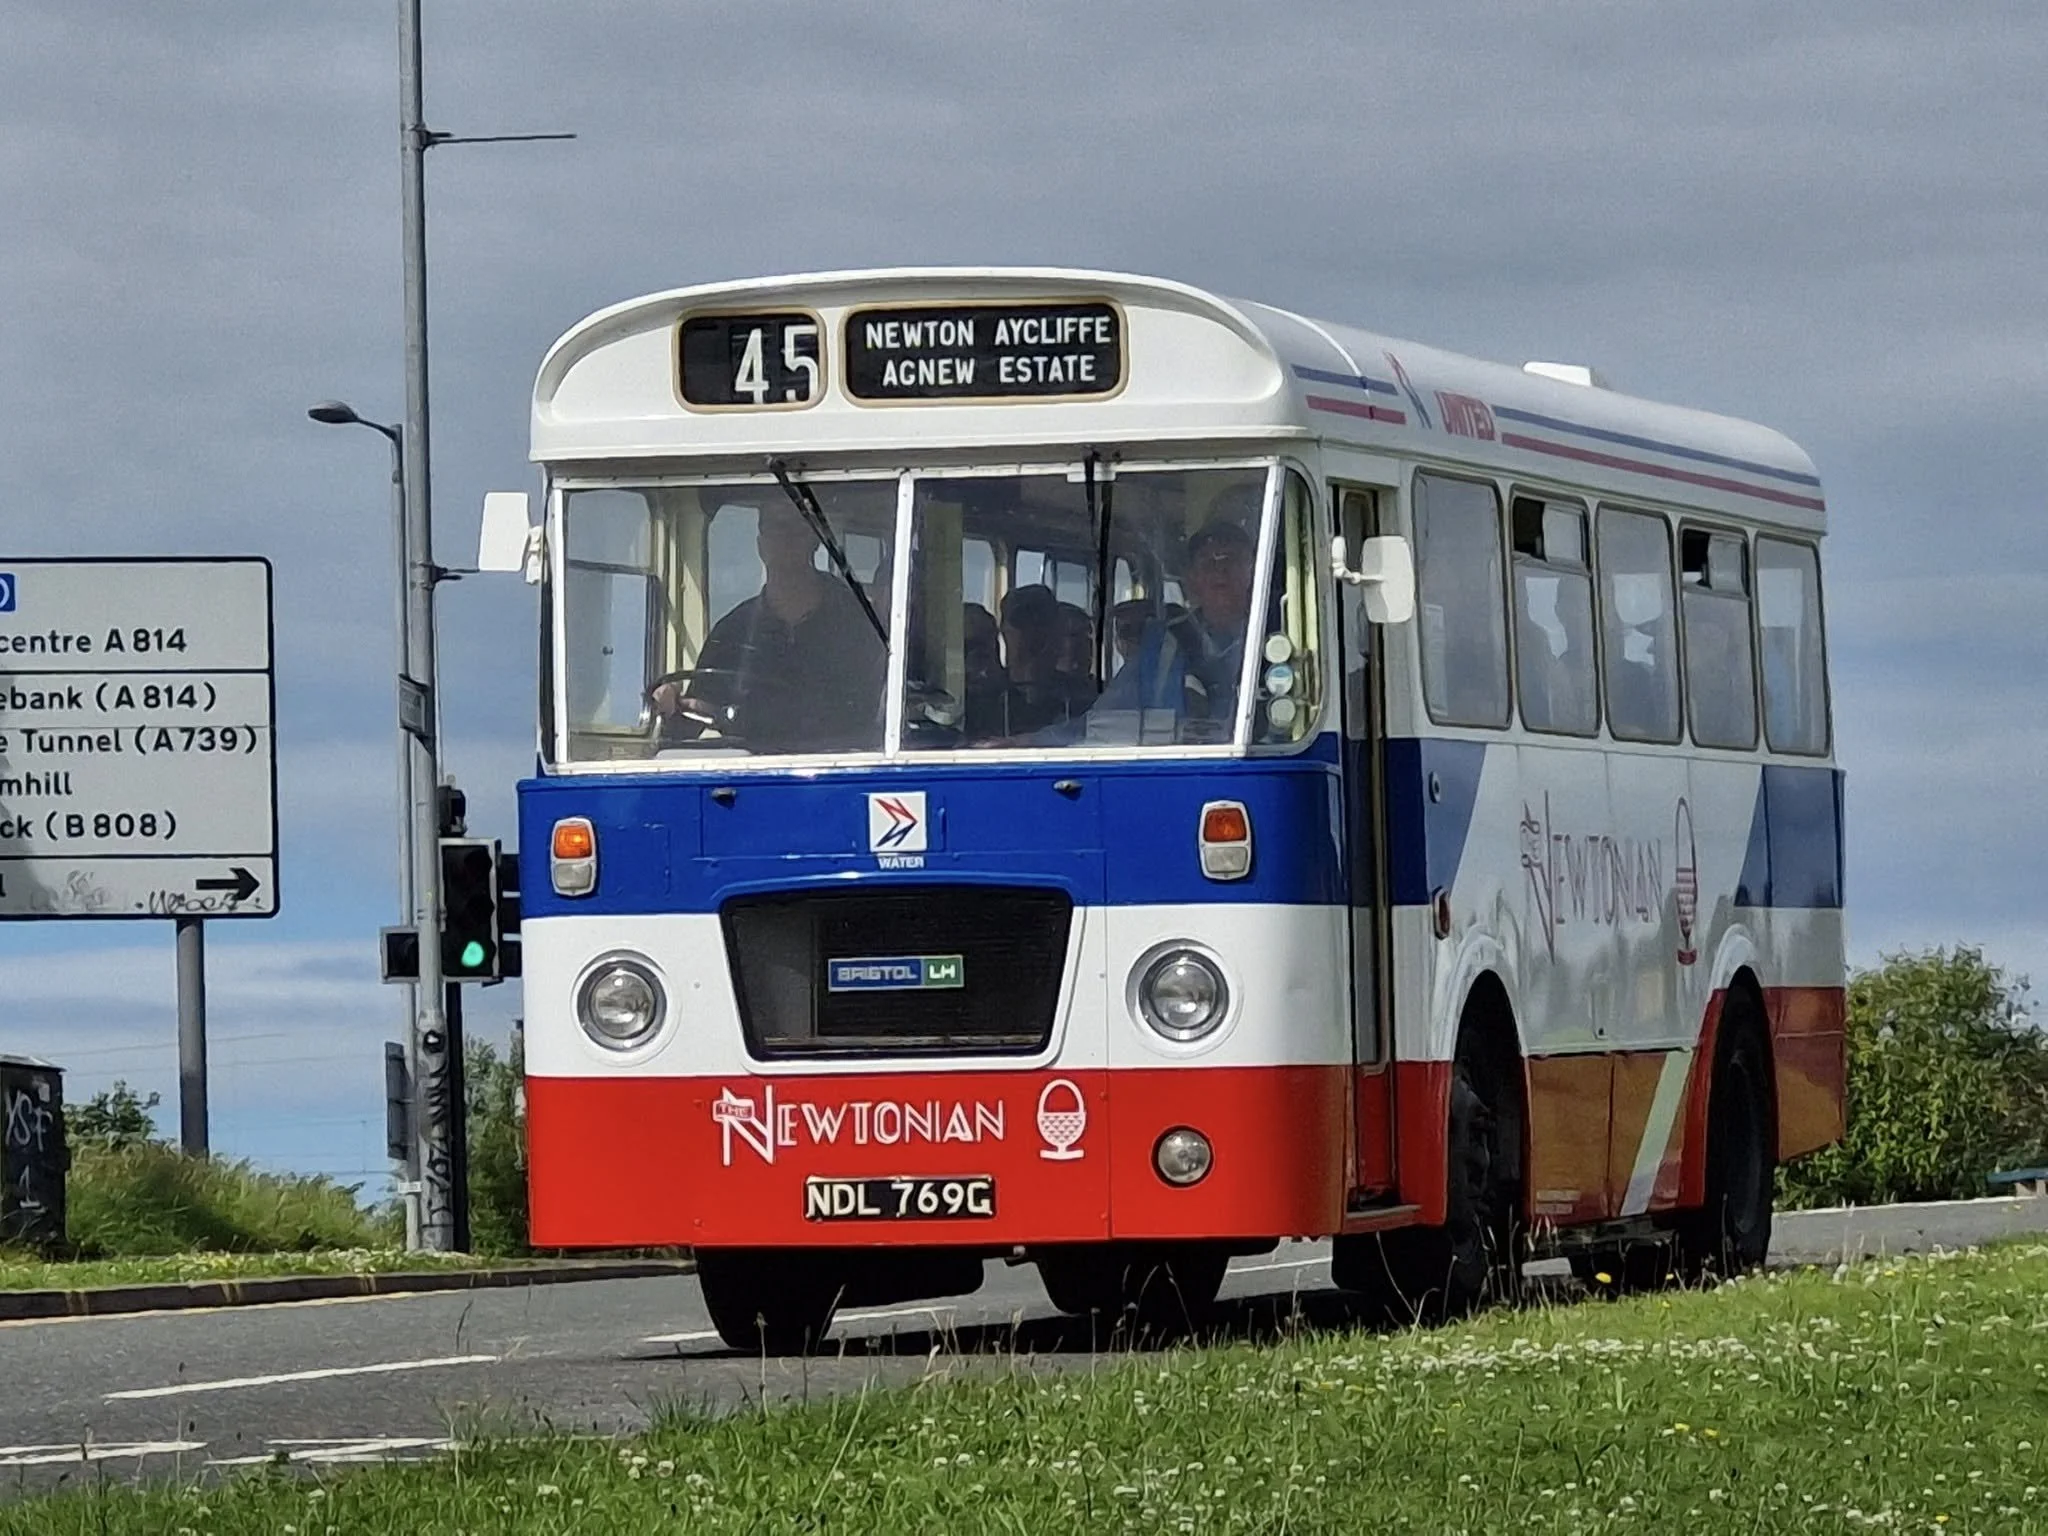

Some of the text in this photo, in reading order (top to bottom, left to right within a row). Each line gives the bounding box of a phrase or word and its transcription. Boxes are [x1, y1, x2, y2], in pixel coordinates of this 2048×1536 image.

[866, 316, 1111, 349] NEWTON AYCLIFFE
[735, 325, 819, 404] 45
[882, 354, 1096, 386] AGNEW ESTATE
[19, 728, 123, 753] Tunnel
[877, 855, 925, 869] WATER
[837, 964, 956, 981] BRISTOL LH
[713, 1085, 1004, 1166] THE NEWTONIAN
[807, 1182, 993, 1216] NDL 769G
